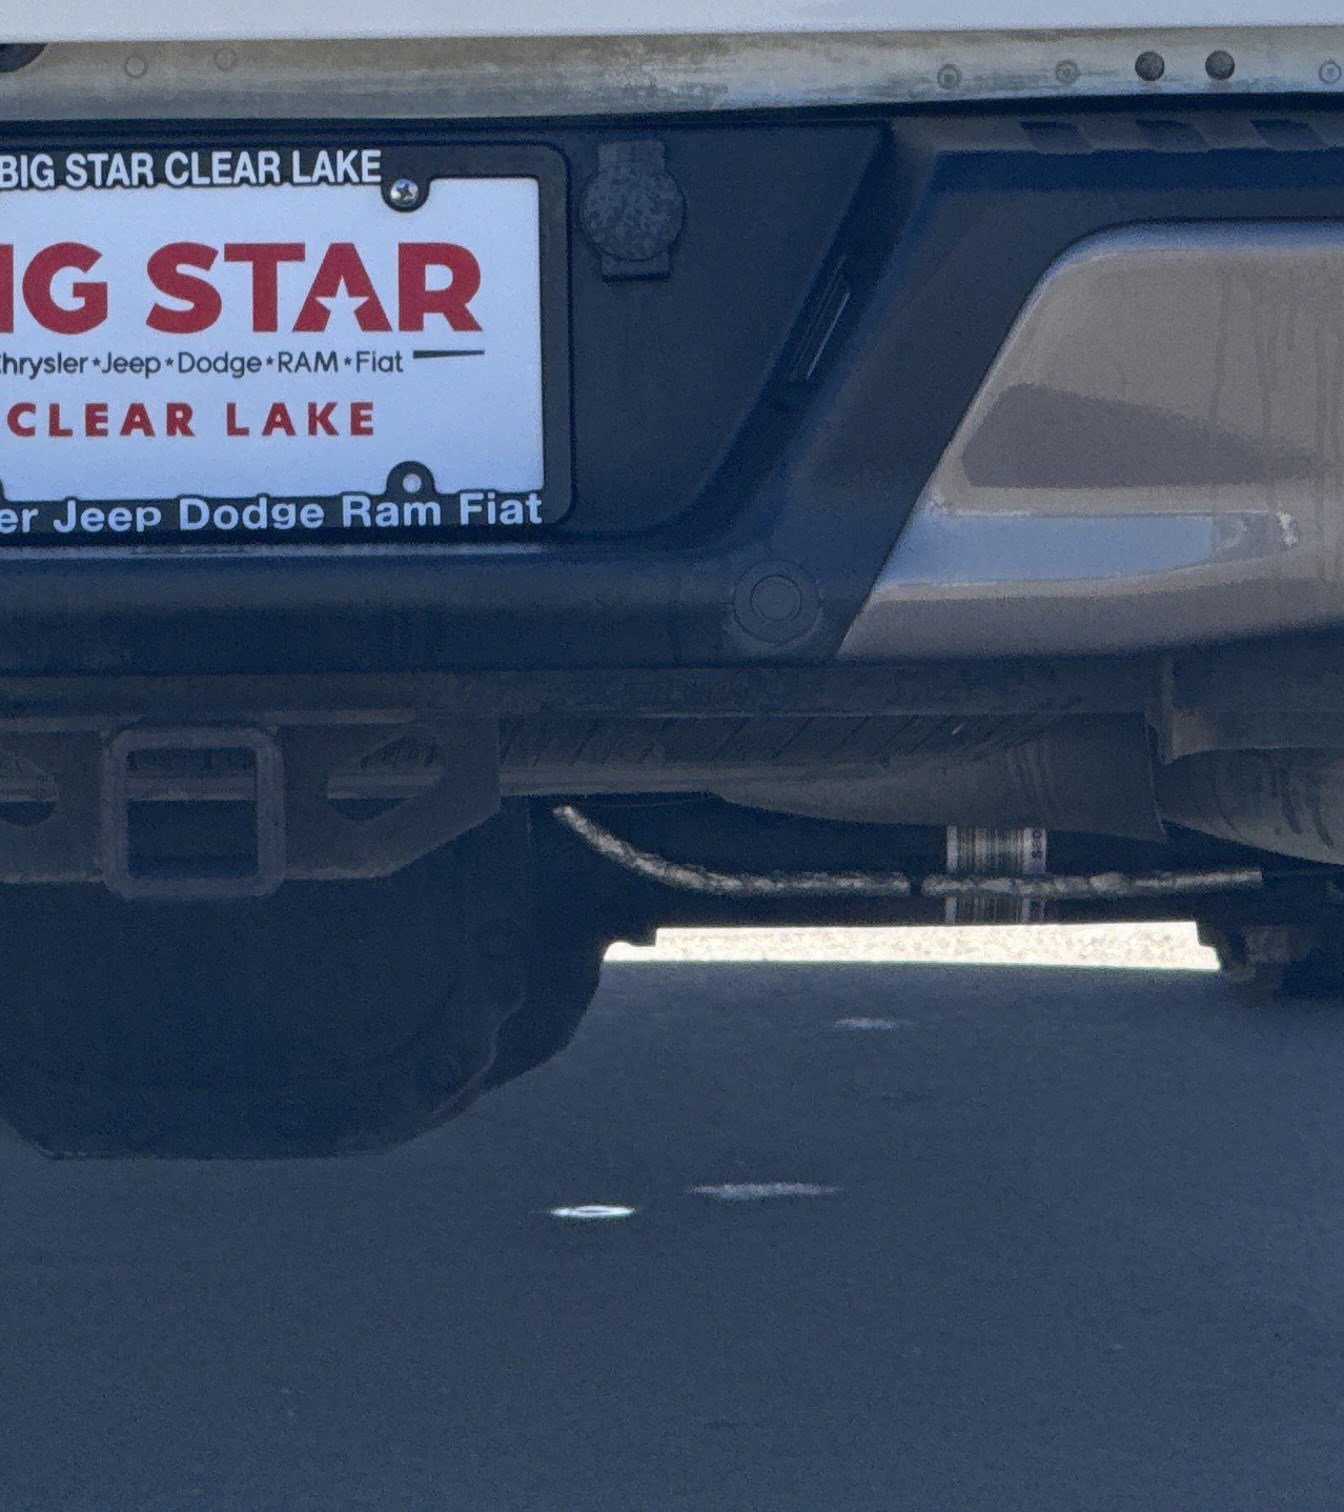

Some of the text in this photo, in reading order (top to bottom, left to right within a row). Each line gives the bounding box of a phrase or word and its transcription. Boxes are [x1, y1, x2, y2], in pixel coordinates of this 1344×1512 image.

[65, 153, 155, 187] STAR
[164, 151, 282, 186] CLEAR
[292, 150, 382, 184] LAKE
[145, 241, 484, 334] STAR
[101, 351, 162, 380] Jeep
[177, 351, 262, 380] Dodge
[277, 351, 339, 374] RAM
[356, 350, 404, 373] Fiat
[6, 401, 375, 438] CLEAR LAKE
[52, 499, 163, 533] Jeep
[179, 496, 326, 532] Dodge
[342, 495, 442, 528] Ram
[460, 492, 544, 525] Fiat
